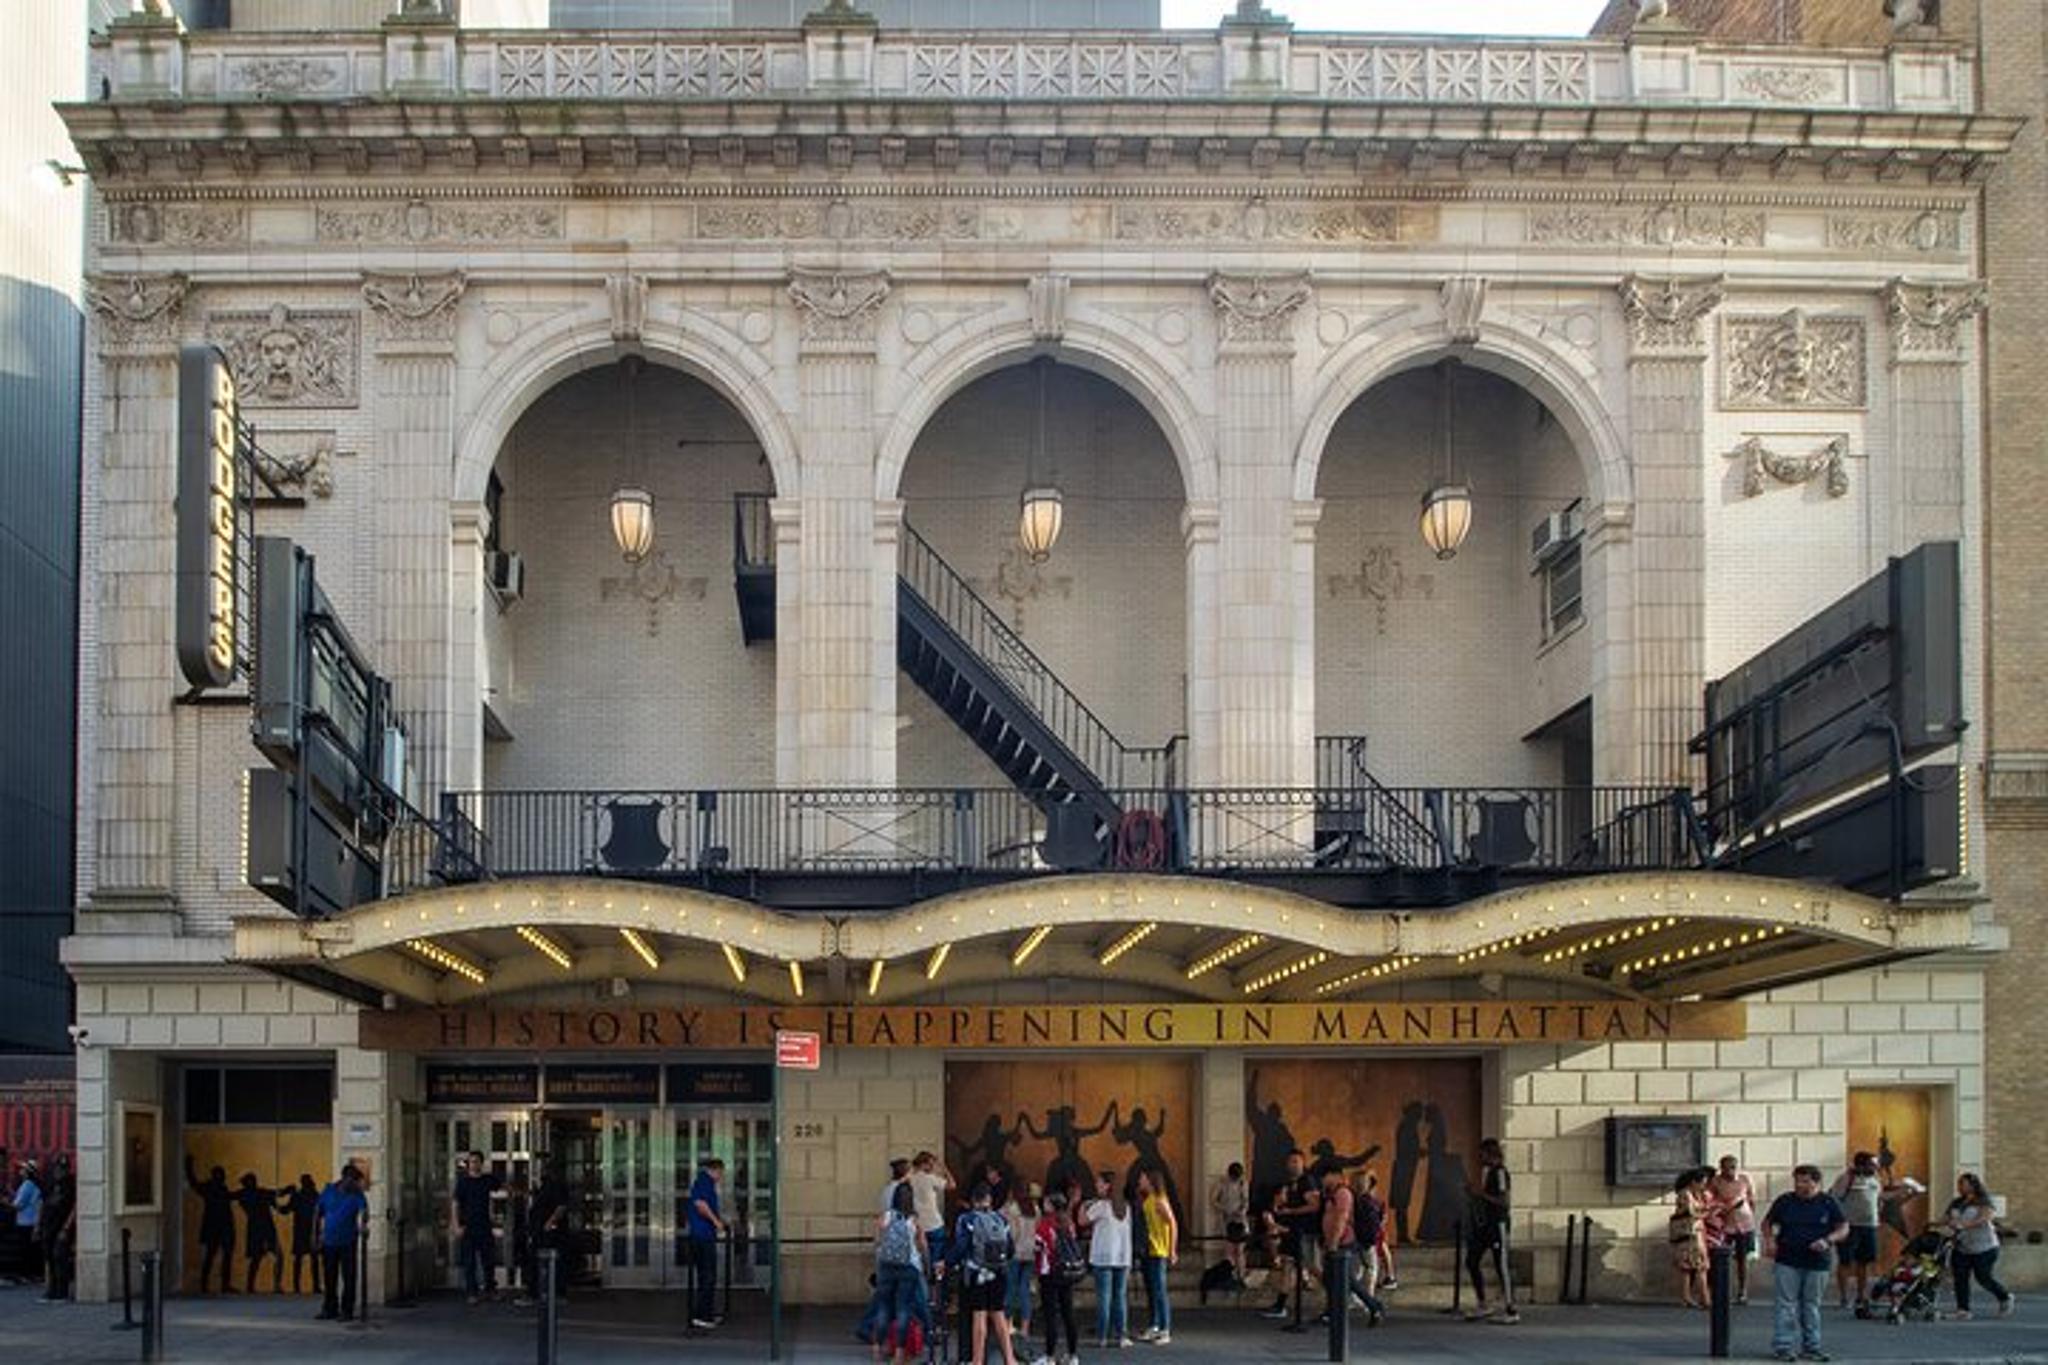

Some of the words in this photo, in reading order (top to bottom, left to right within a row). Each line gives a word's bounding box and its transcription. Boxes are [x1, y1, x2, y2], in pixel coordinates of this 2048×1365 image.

[212, 363, 234, 669] RODGERS
[440, 1011, 699, 1044] HISTORY
[739, 1010, 784, 1043] IS
[827, 1010, 1173, 1043] HAPPENING
[1214, 1008, 1272, 1040] IN
[1313, 1005, 1672, 1039] MANHATTAN
